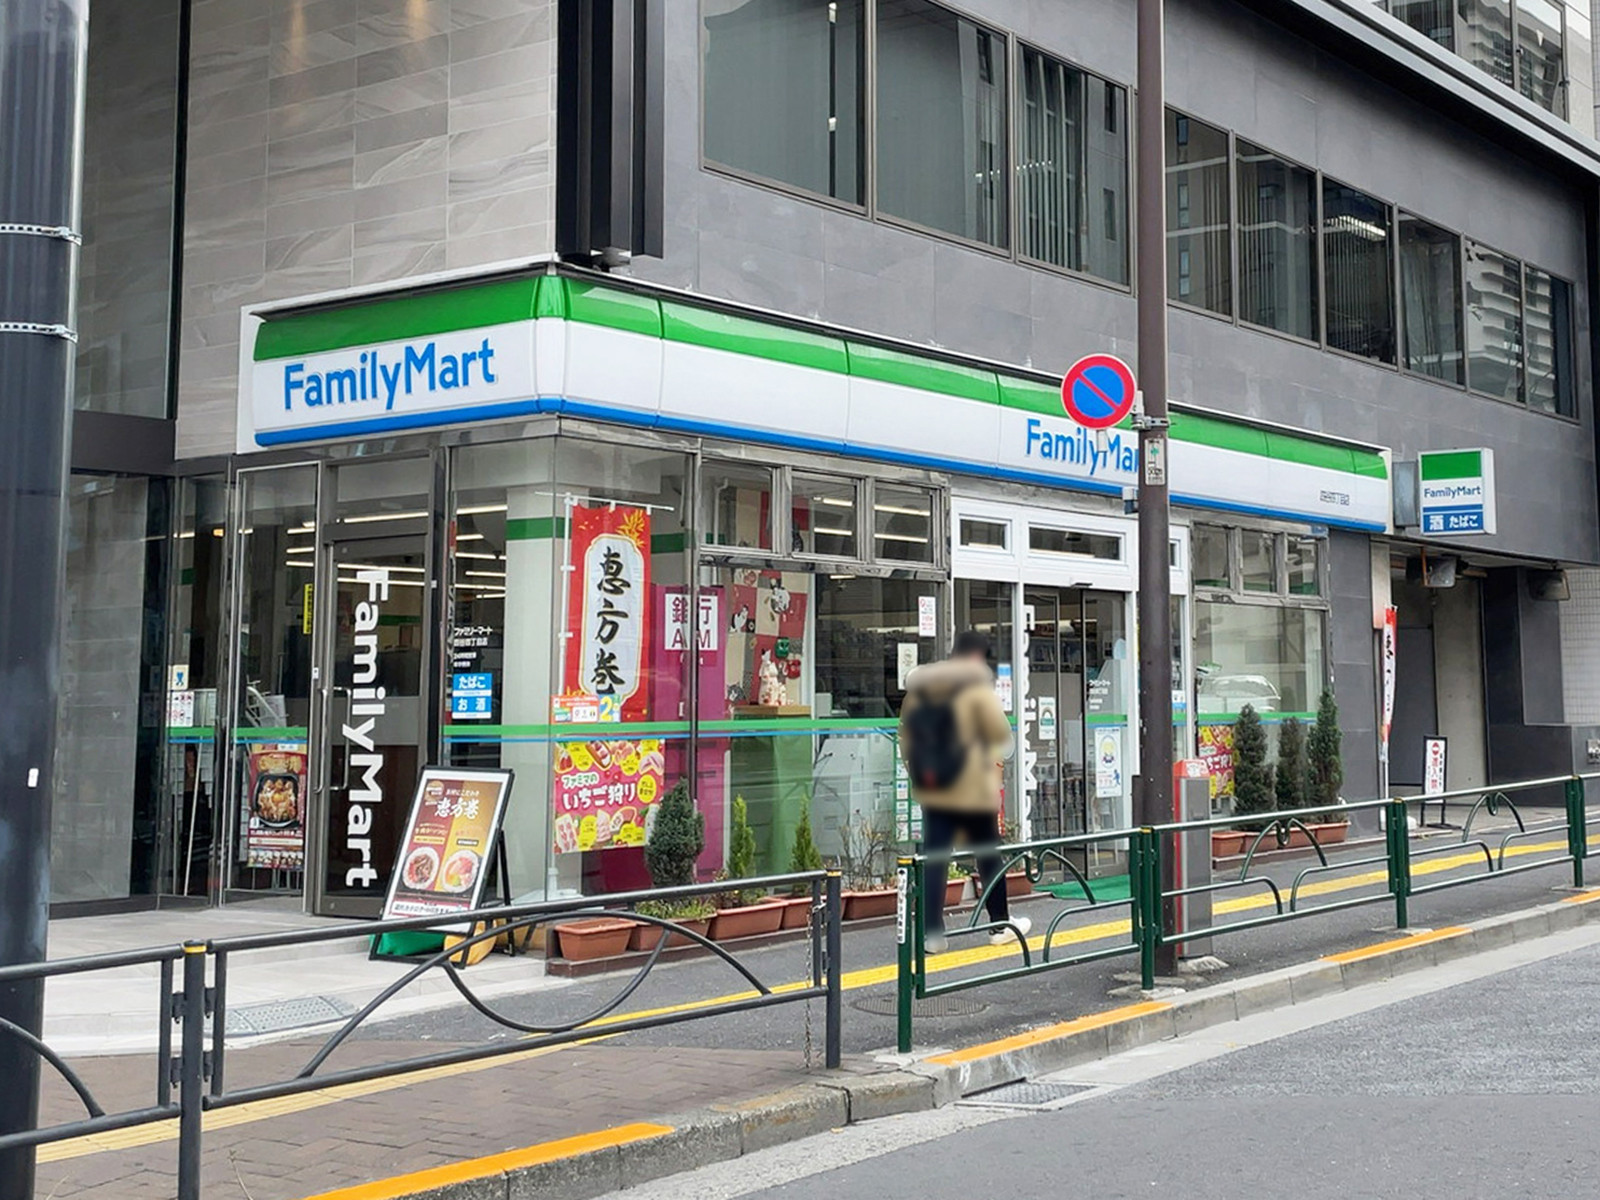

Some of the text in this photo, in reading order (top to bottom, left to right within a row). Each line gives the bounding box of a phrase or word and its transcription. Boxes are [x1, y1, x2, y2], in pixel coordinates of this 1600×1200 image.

[284, 338, 495, 410] FamilyMart
[1424, 486, 1482, 499] FamilyMart
[1429, 515, 1478, 530] 酒 たばこ
[591, 546, 631, 695] 恵方巻
[672, 628, 711, 649] AM
[458, 676, 486, 689] たばこ
[342, 569, 389, 888] FamilyMart
[562, 773, 598, 787] ファミマの
[563, 784, 636, 810] いちご狩り
